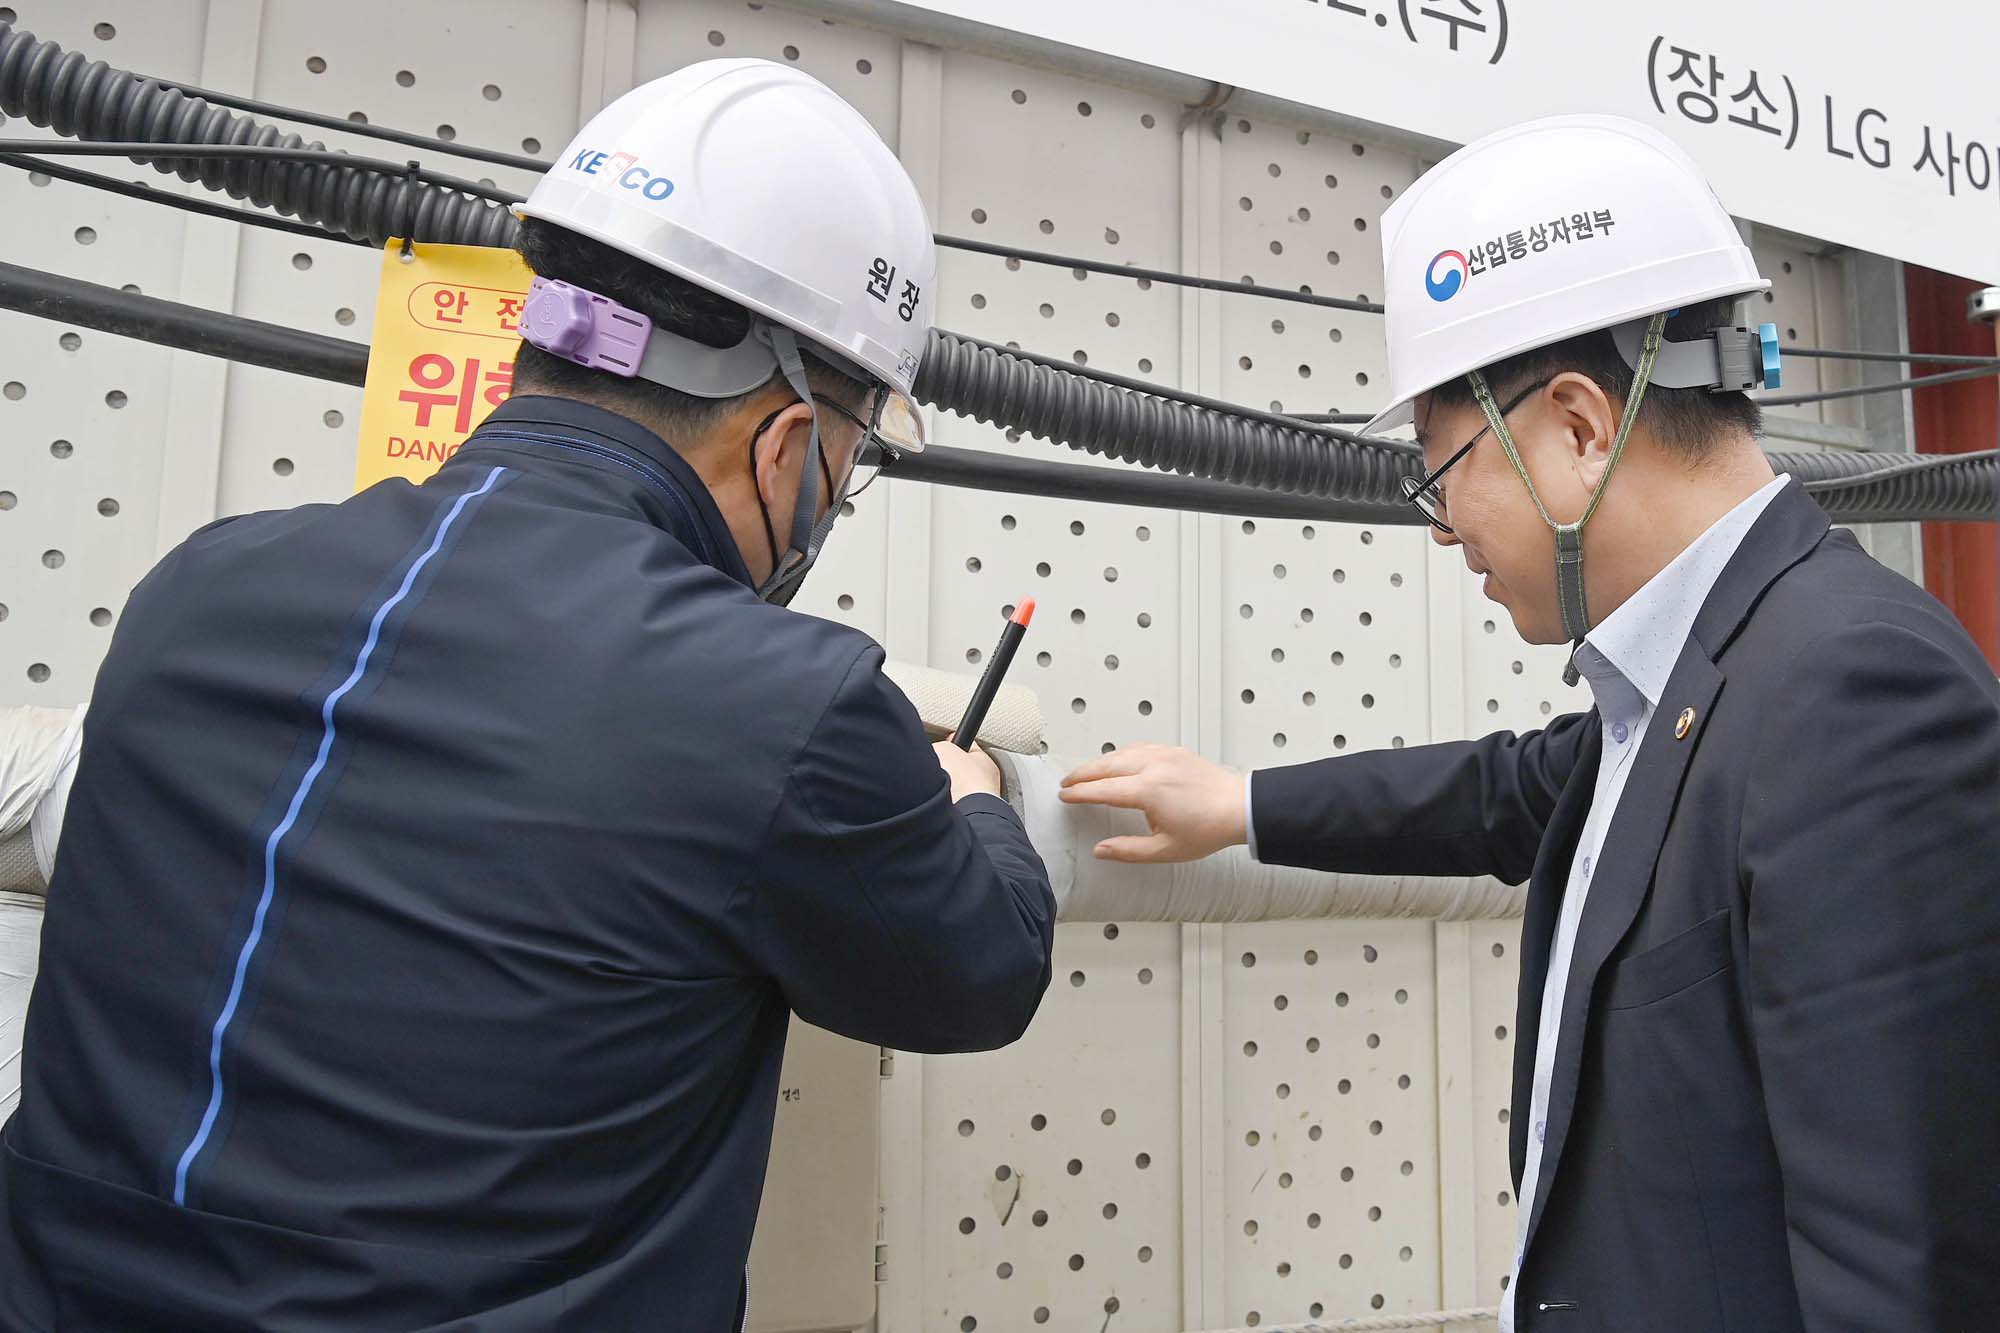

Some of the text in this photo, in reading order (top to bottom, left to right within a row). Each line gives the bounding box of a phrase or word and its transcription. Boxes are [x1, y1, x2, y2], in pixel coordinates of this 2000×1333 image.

[1648, 35, 1799, 151] (장소)
[1825, 95, 1891, 169] LG
[1467, 208, 1616, 277] 산업통상자원부
